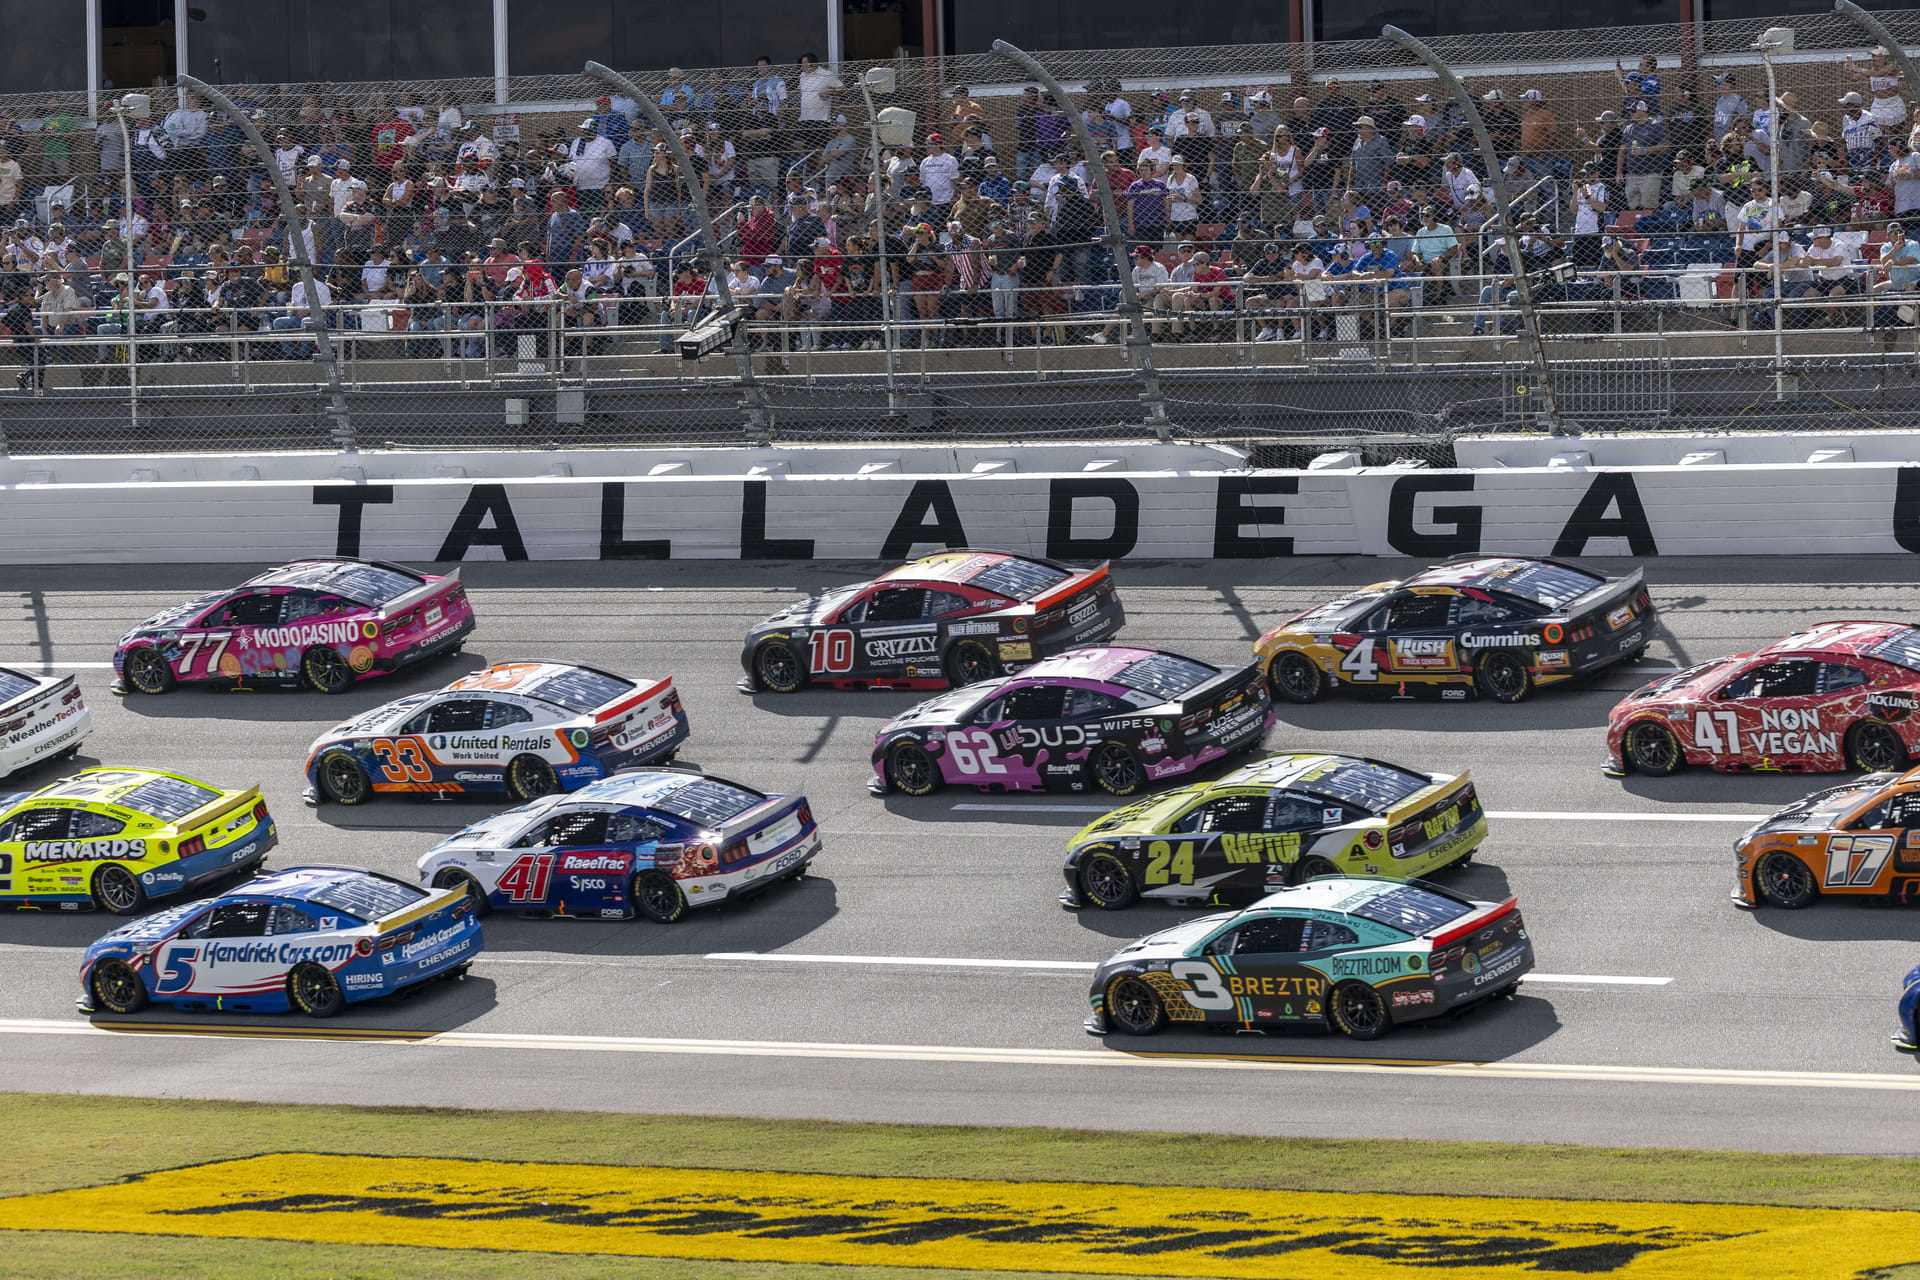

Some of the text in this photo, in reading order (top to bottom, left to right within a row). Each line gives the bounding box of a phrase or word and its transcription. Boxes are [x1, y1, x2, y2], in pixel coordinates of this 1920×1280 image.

[313, 472, 1659, 561] TALLADEGA
[420, 621, 463, 647] CHEVROLET
[1075, 617, 1112, 641] CHEVROLET
[1460, 631, 1541, 647] Cummins
[1619, 632, 1642, 650] FORD
[178, 631, 233, 675] 77
[808, 629, 855, 673] 10
[865, 636, 937, 658] GRIZZLY
[1396, 637, 1448, 658] RUSH
[870, 655, 940, 666] NICOTINE POUCHES
[1340, 637, 1380, 682] 4
[1864, 693, 1889, 706] JACK
[8, 705, 77, 744] WeatherTech
[1205, 712, 1232, 734] DUDE
[1209, 721, 1240, 738] WIPES
[1221, 715, 1264, 745] CHEVROLET
[1760, 707, 1822, 731] NON
[34, 727, 79, 754] CHEVROLET
[450, 735, 552, 751] United Rentals
[632, 727, 678, 756] CHEVROLET
[1020, 724, 1103, 748] DUDE
[1103, 718, 1155, 731] WIPES
[1694, 709, 1742, 755] 47
[1749, 731, 1838, 754] VEGAN
[372, 738, 433, 783] 33
[452, 752, 500, 760] Work United
[947, 730, 1008, 774] 62
[25, 839, 147, 862] MENARDS
[232, 842, 256, 863] FORD
[1428, 826, 1476, 859] CHEVROLET
[563, 855, 626, 871] RaceTrac
[775, 850, 801, 870] FORD
[1145, 840, 1195, 886] 24
[1823, 833, 1897, 888] 17
[495, 853, 558, 903] 41
[570, 875, 607, 891] Sysco
[467, 914, 475, 926] 5
[418, 938, 471, 969] CHEVROLET
[155, 946, 200, 995] 5
[1332, 957, 1401, 976] BREZTRI.COM
[1474, 955, 1522, 986] CHEVROLET
[345, 973, 383, 985] HIRING
[1170, 961, 1235, 1011] 3
[1229, 977, 1326, 996] BREZTRI
